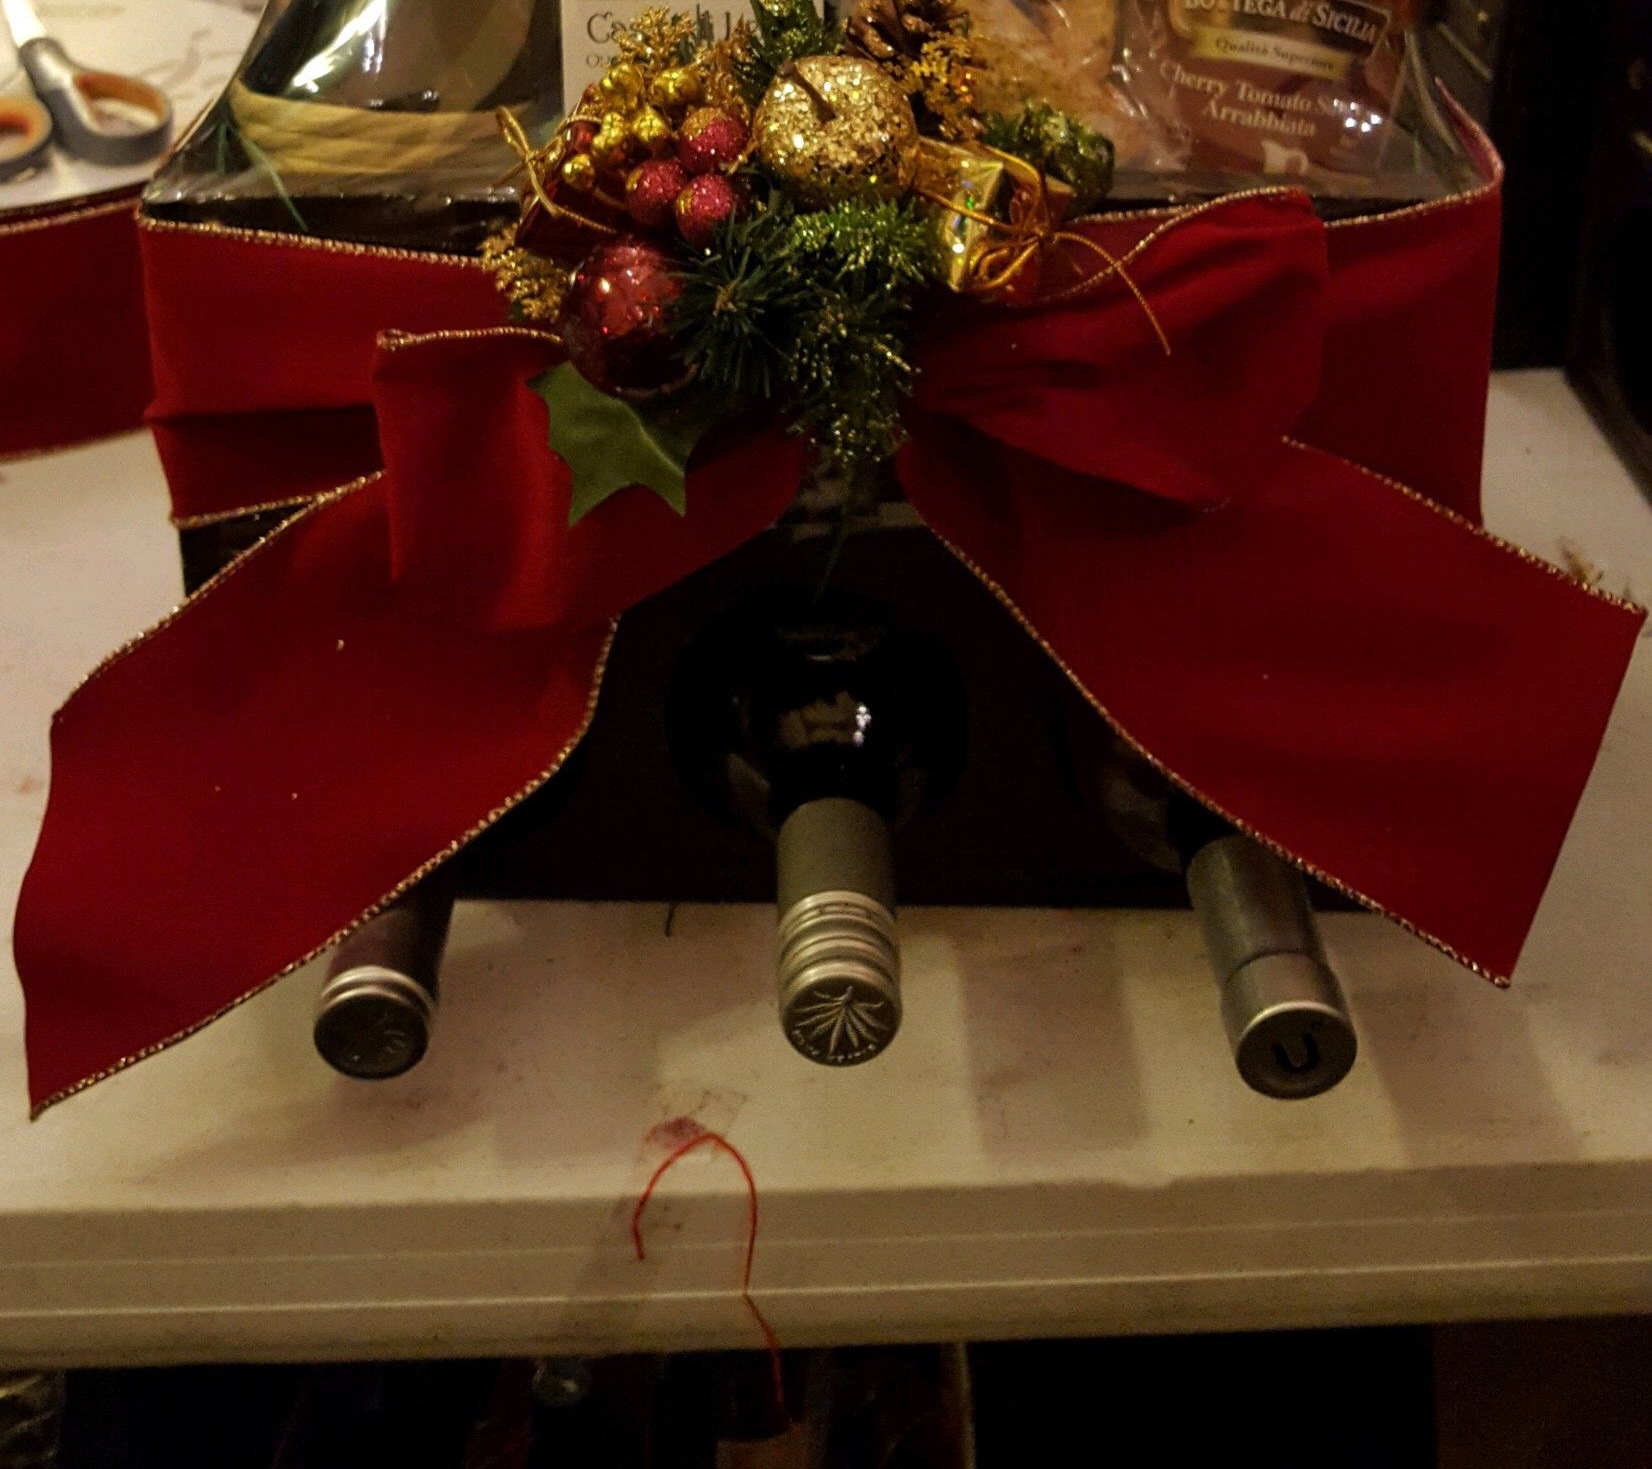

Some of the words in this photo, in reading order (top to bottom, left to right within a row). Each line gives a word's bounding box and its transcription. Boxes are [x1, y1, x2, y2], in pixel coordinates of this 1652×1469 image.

[1159, 58, 1229, 98] Cherry
[1236, 82, 1311, 112] Tomato
[1202, 98, 1317, 138] Arrabbiata
